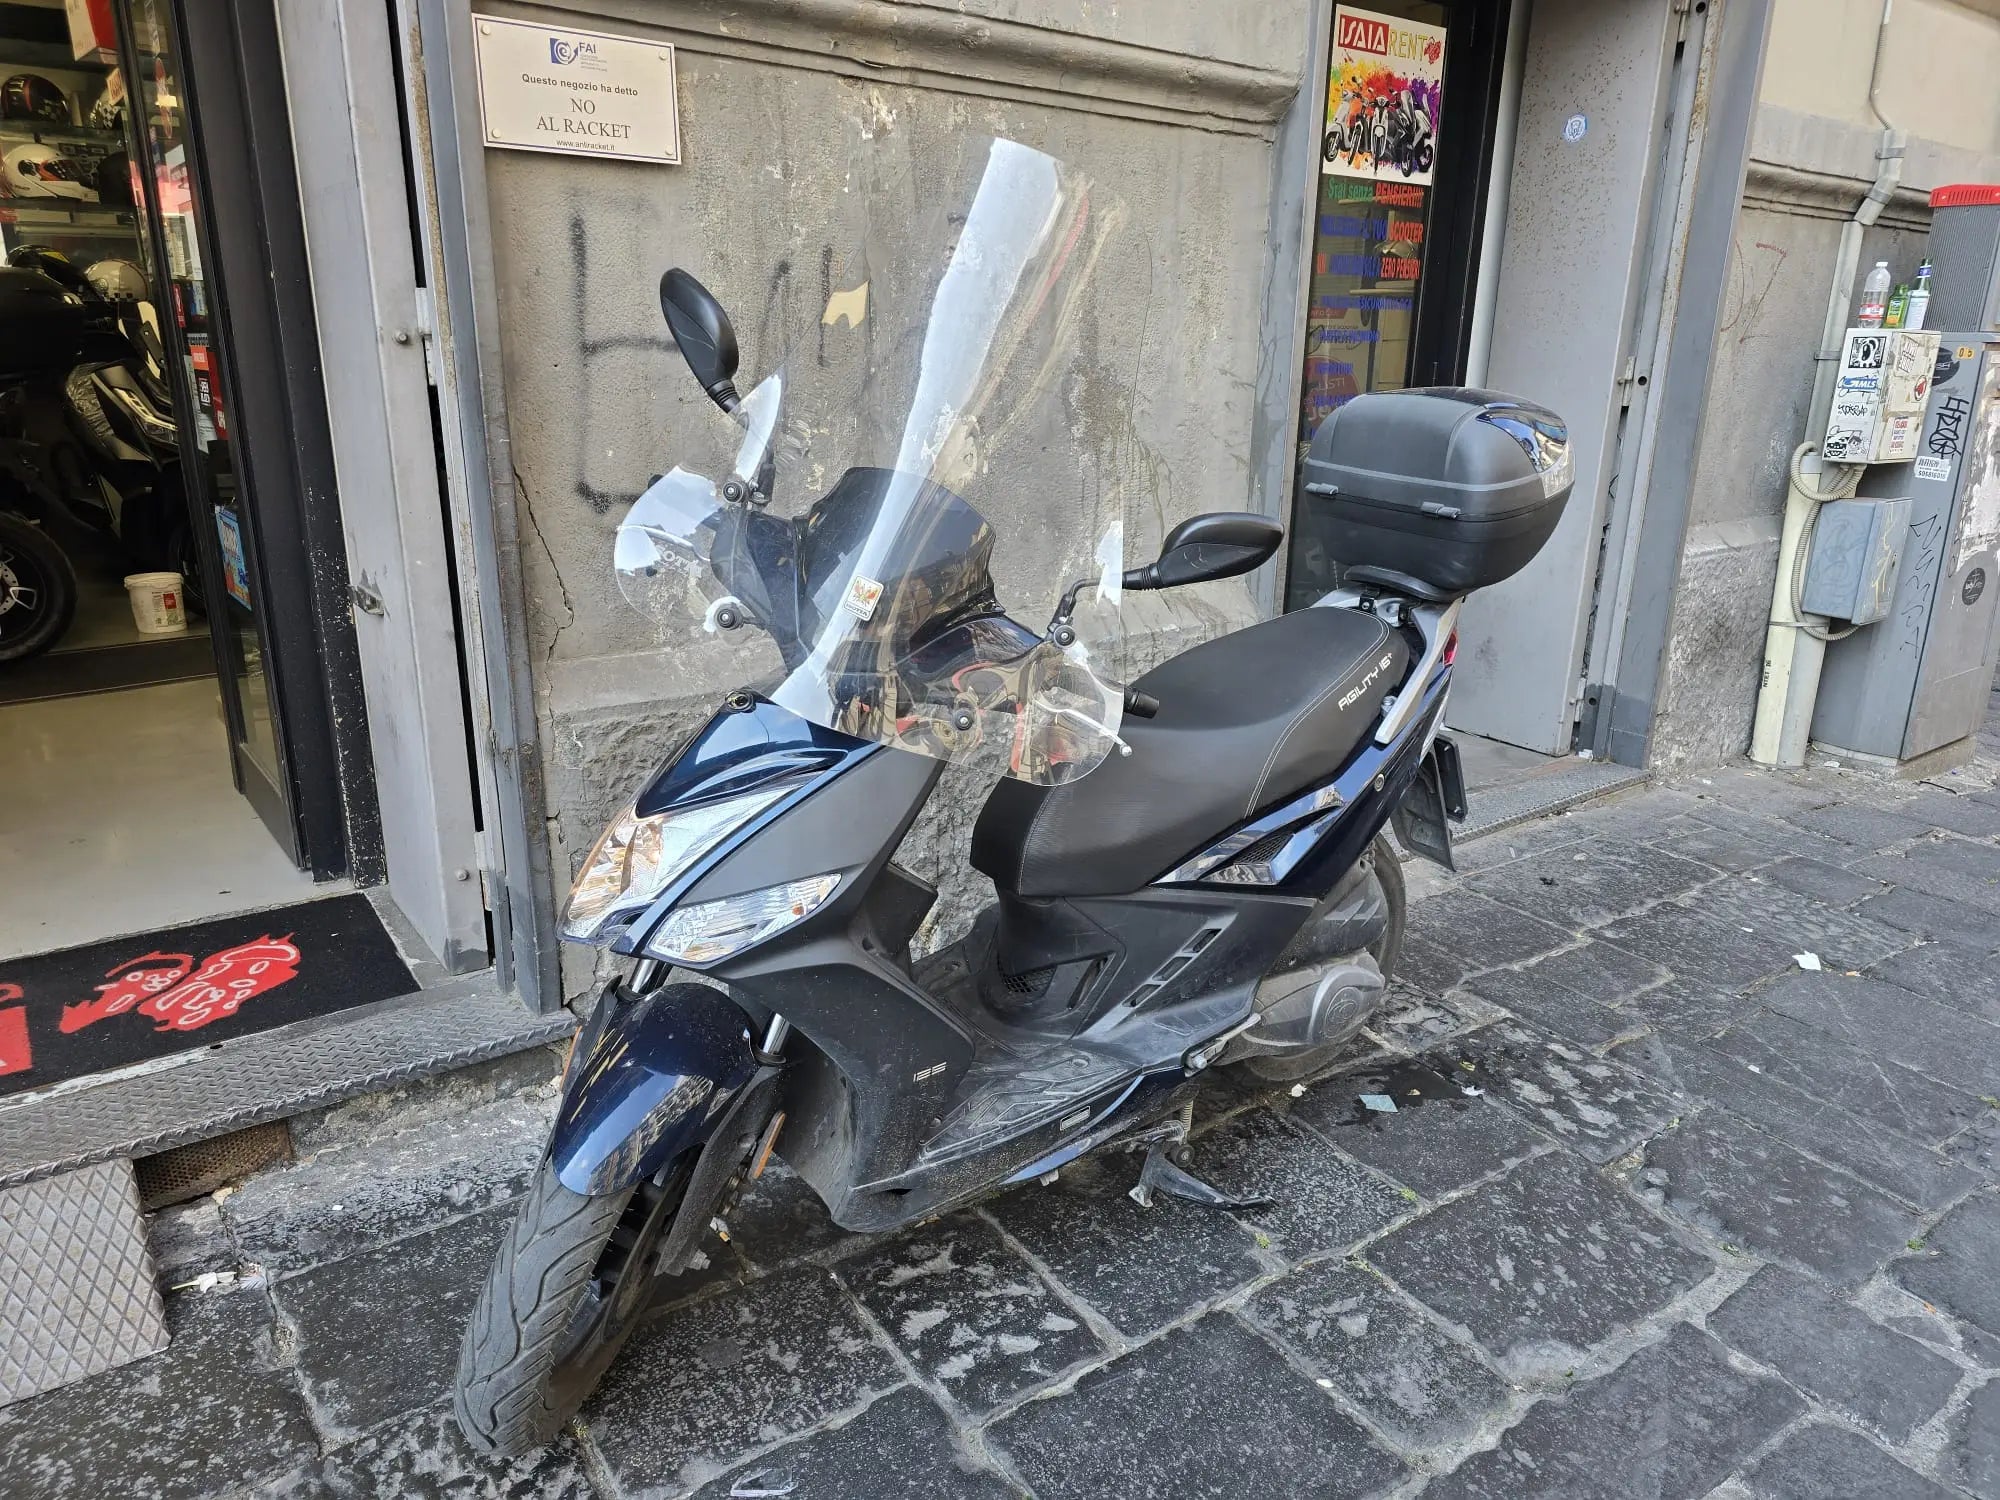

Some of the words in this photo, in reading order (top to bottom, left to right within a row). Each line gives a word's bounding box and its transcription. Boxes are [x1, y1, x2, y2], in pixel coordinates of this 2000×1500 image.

[579, 42, 596, 54] FAI
[1340, 17, 1386, 52] ISAIA
[1388, 28, 1428, 62] RENT
[522, 73, 557, 87] Questo
[560, 79, 598, 92] negozio
[600, 83, 612, 94] ha
[614, 85, 638, 96] detto
[571, 98, 596, 115] NO
[536, 116, 559, 132] AL
[564, 118, 631, 140] RACKET
[1389, 221, 1423, 244] SCOOTER
[1338, 666, 1379, 711] AGILITY
[913, 1061, 947, 1083] 125
